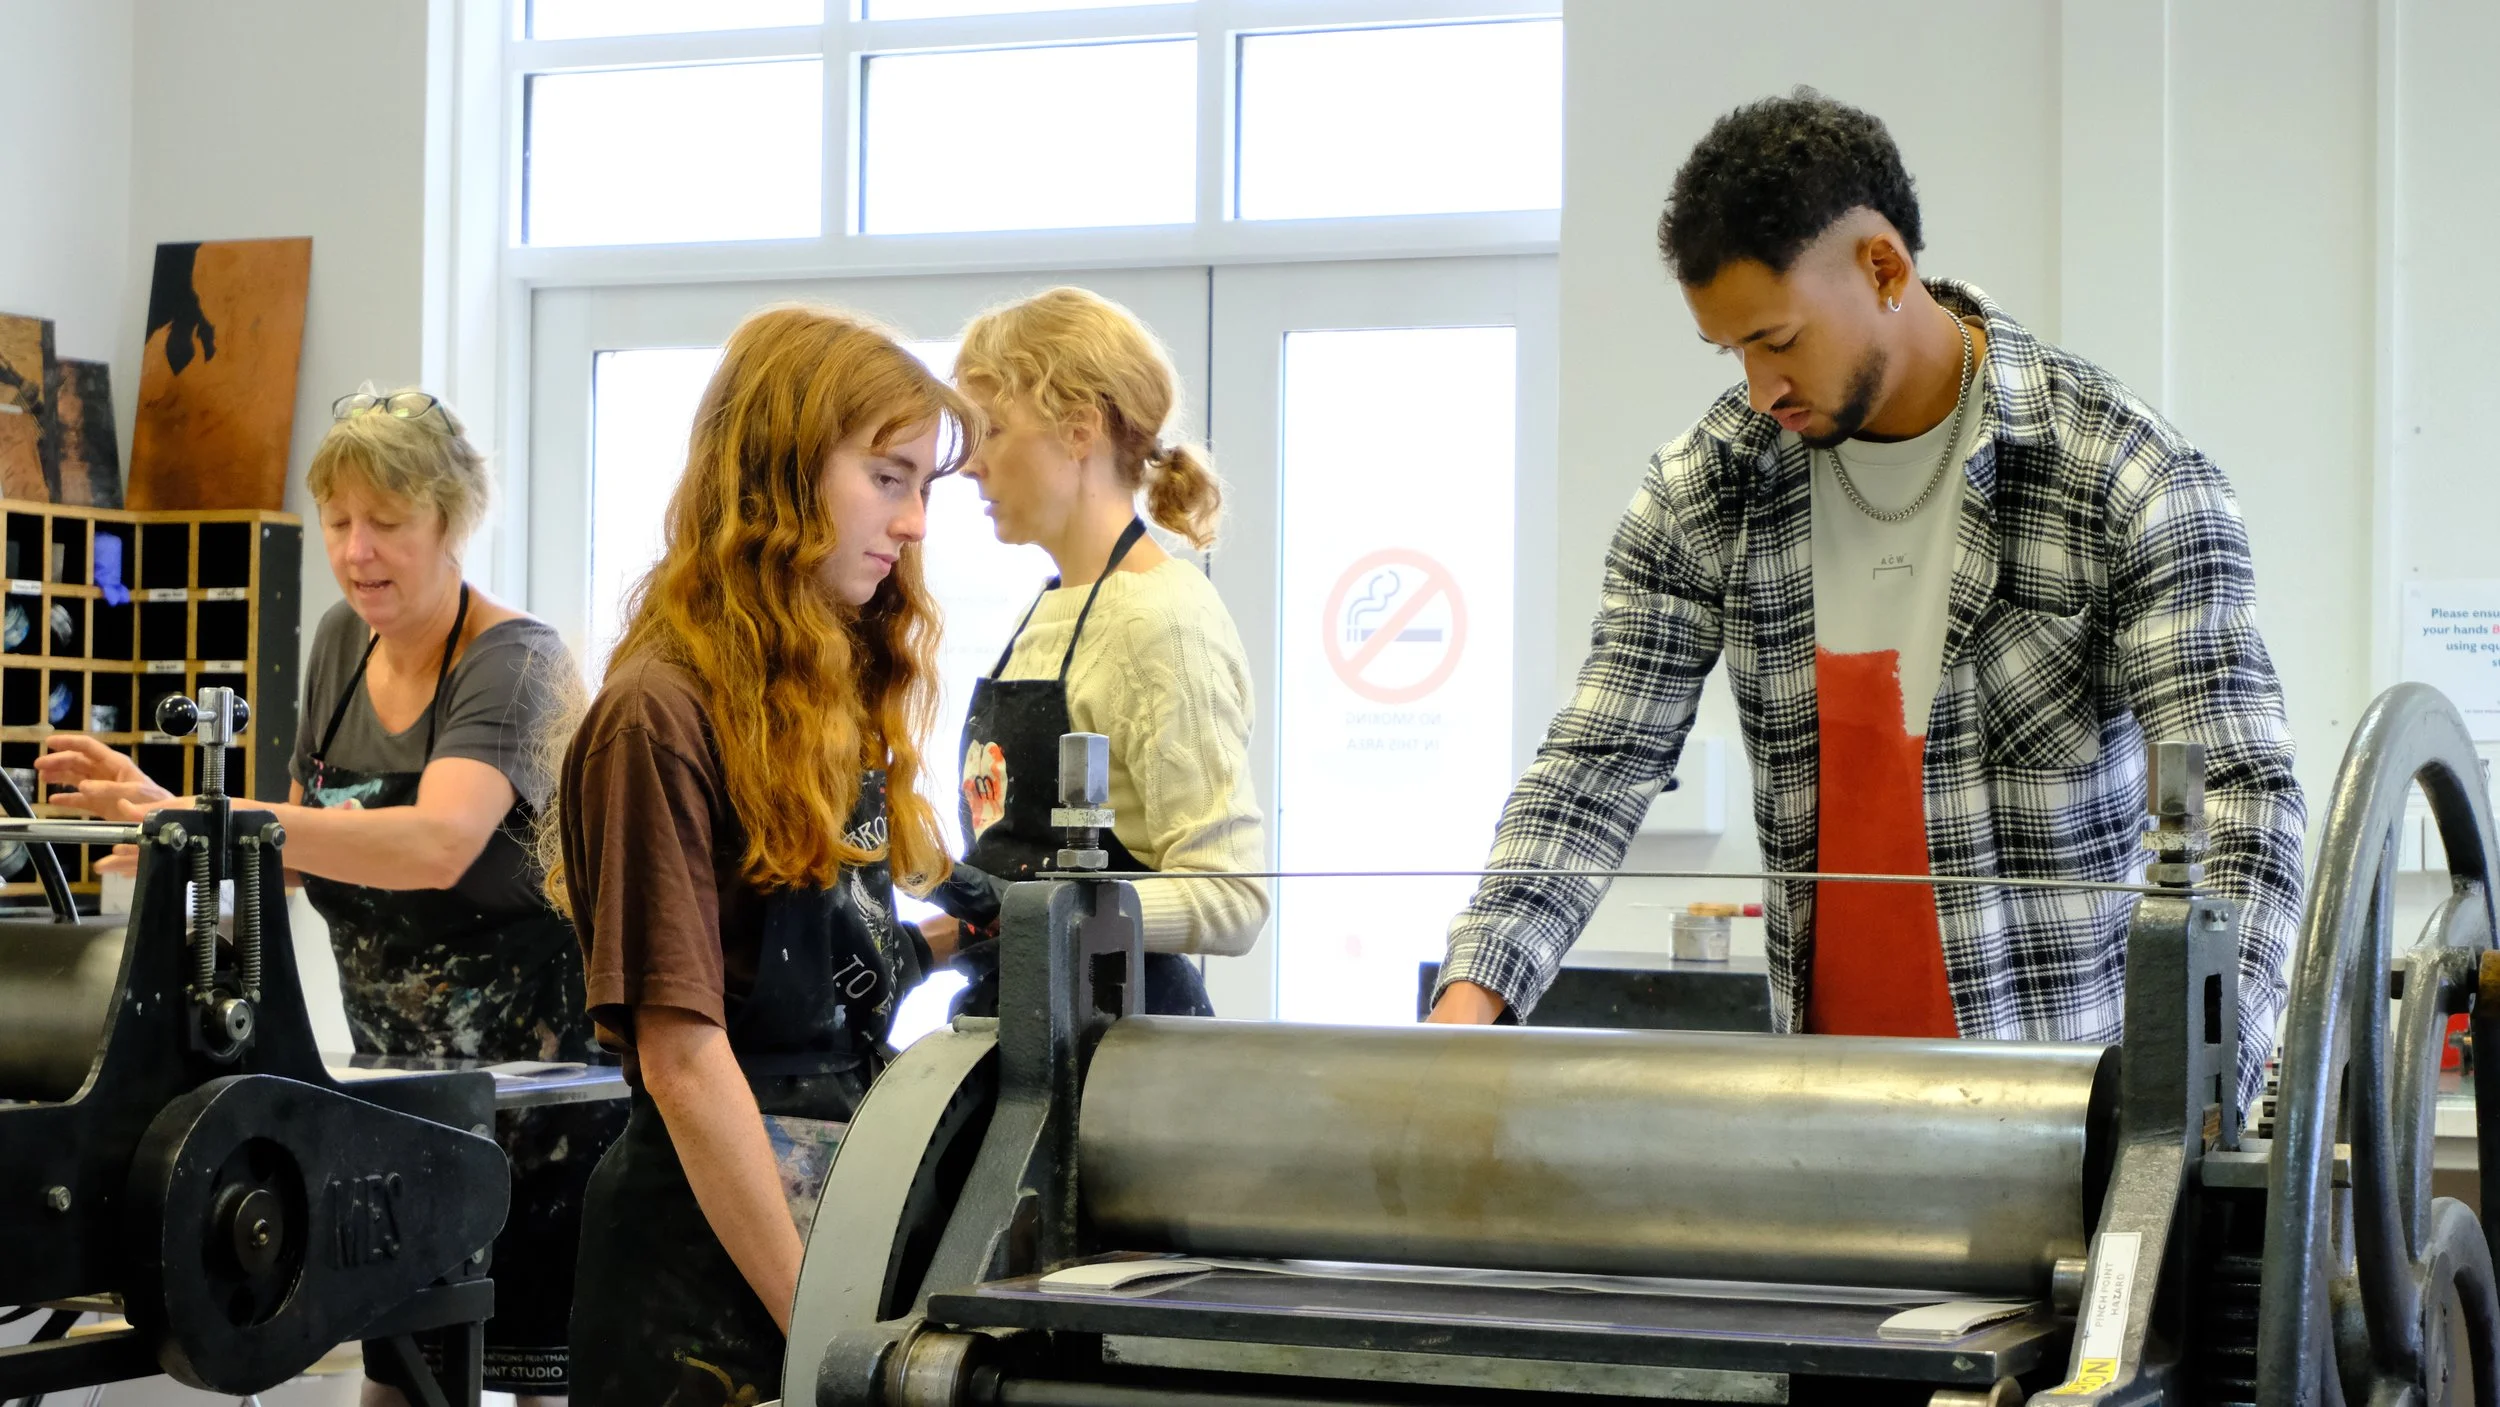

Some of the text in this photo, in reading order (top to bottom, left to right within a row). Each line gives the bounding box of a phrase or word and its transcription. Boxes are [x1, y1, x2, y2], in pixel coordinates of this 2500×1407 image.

[2431, 607, 2469, 618] Please
[2423, 626, 2449, 636] your
[2454, 624, 2488, 634] hands
[2446, 641, 2477, 653] using
[2095, 1262, 2114, 1327] PINCH POINT
[2110, 1273, 2125, 1315] HAZARD
[511, 1366, 563, 1378] STUDIO
